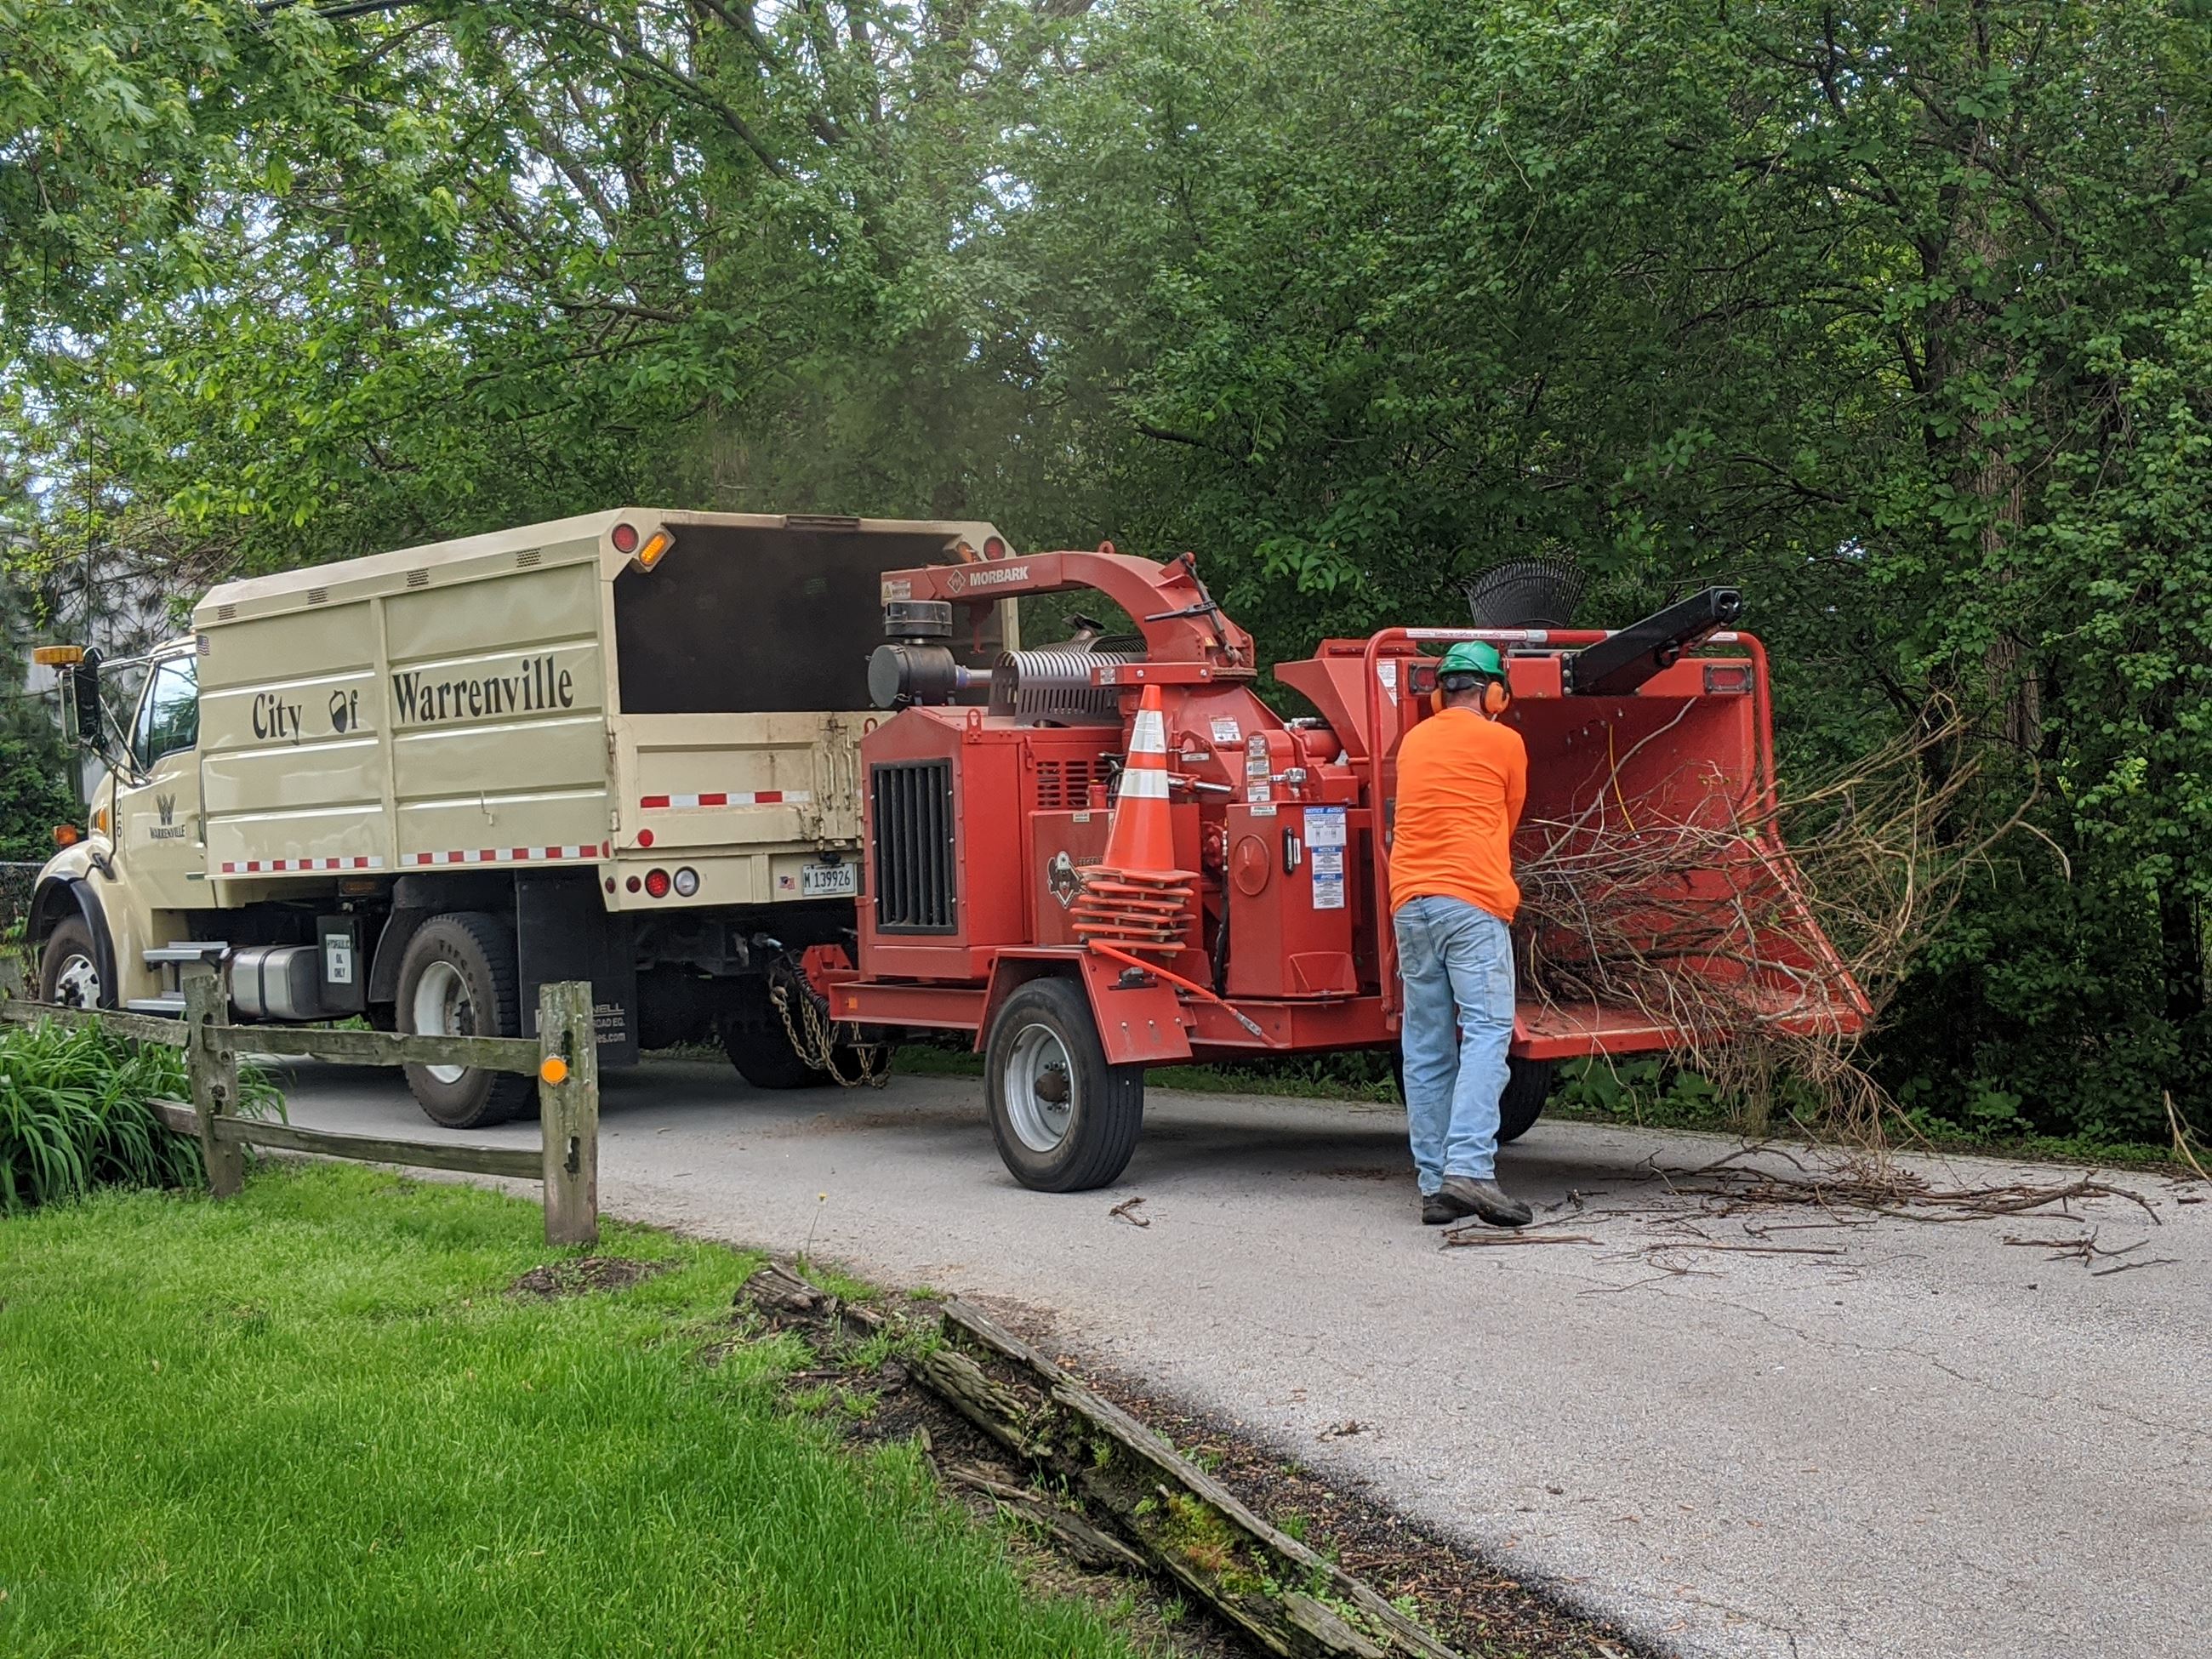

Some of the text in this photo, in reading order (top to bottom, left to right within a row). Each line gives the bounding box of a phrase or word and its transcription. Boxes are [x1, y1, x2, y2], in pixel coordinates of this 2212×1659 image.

[969, 566, 1029, 587] MORBARK
[252, 654, 574, 745] City Of Warrenville
[149, 824, 185, 839] WARRENVILLE
[804, 870, 851, 888] M 139926
[592, 1002, 625, 1013] NELL
